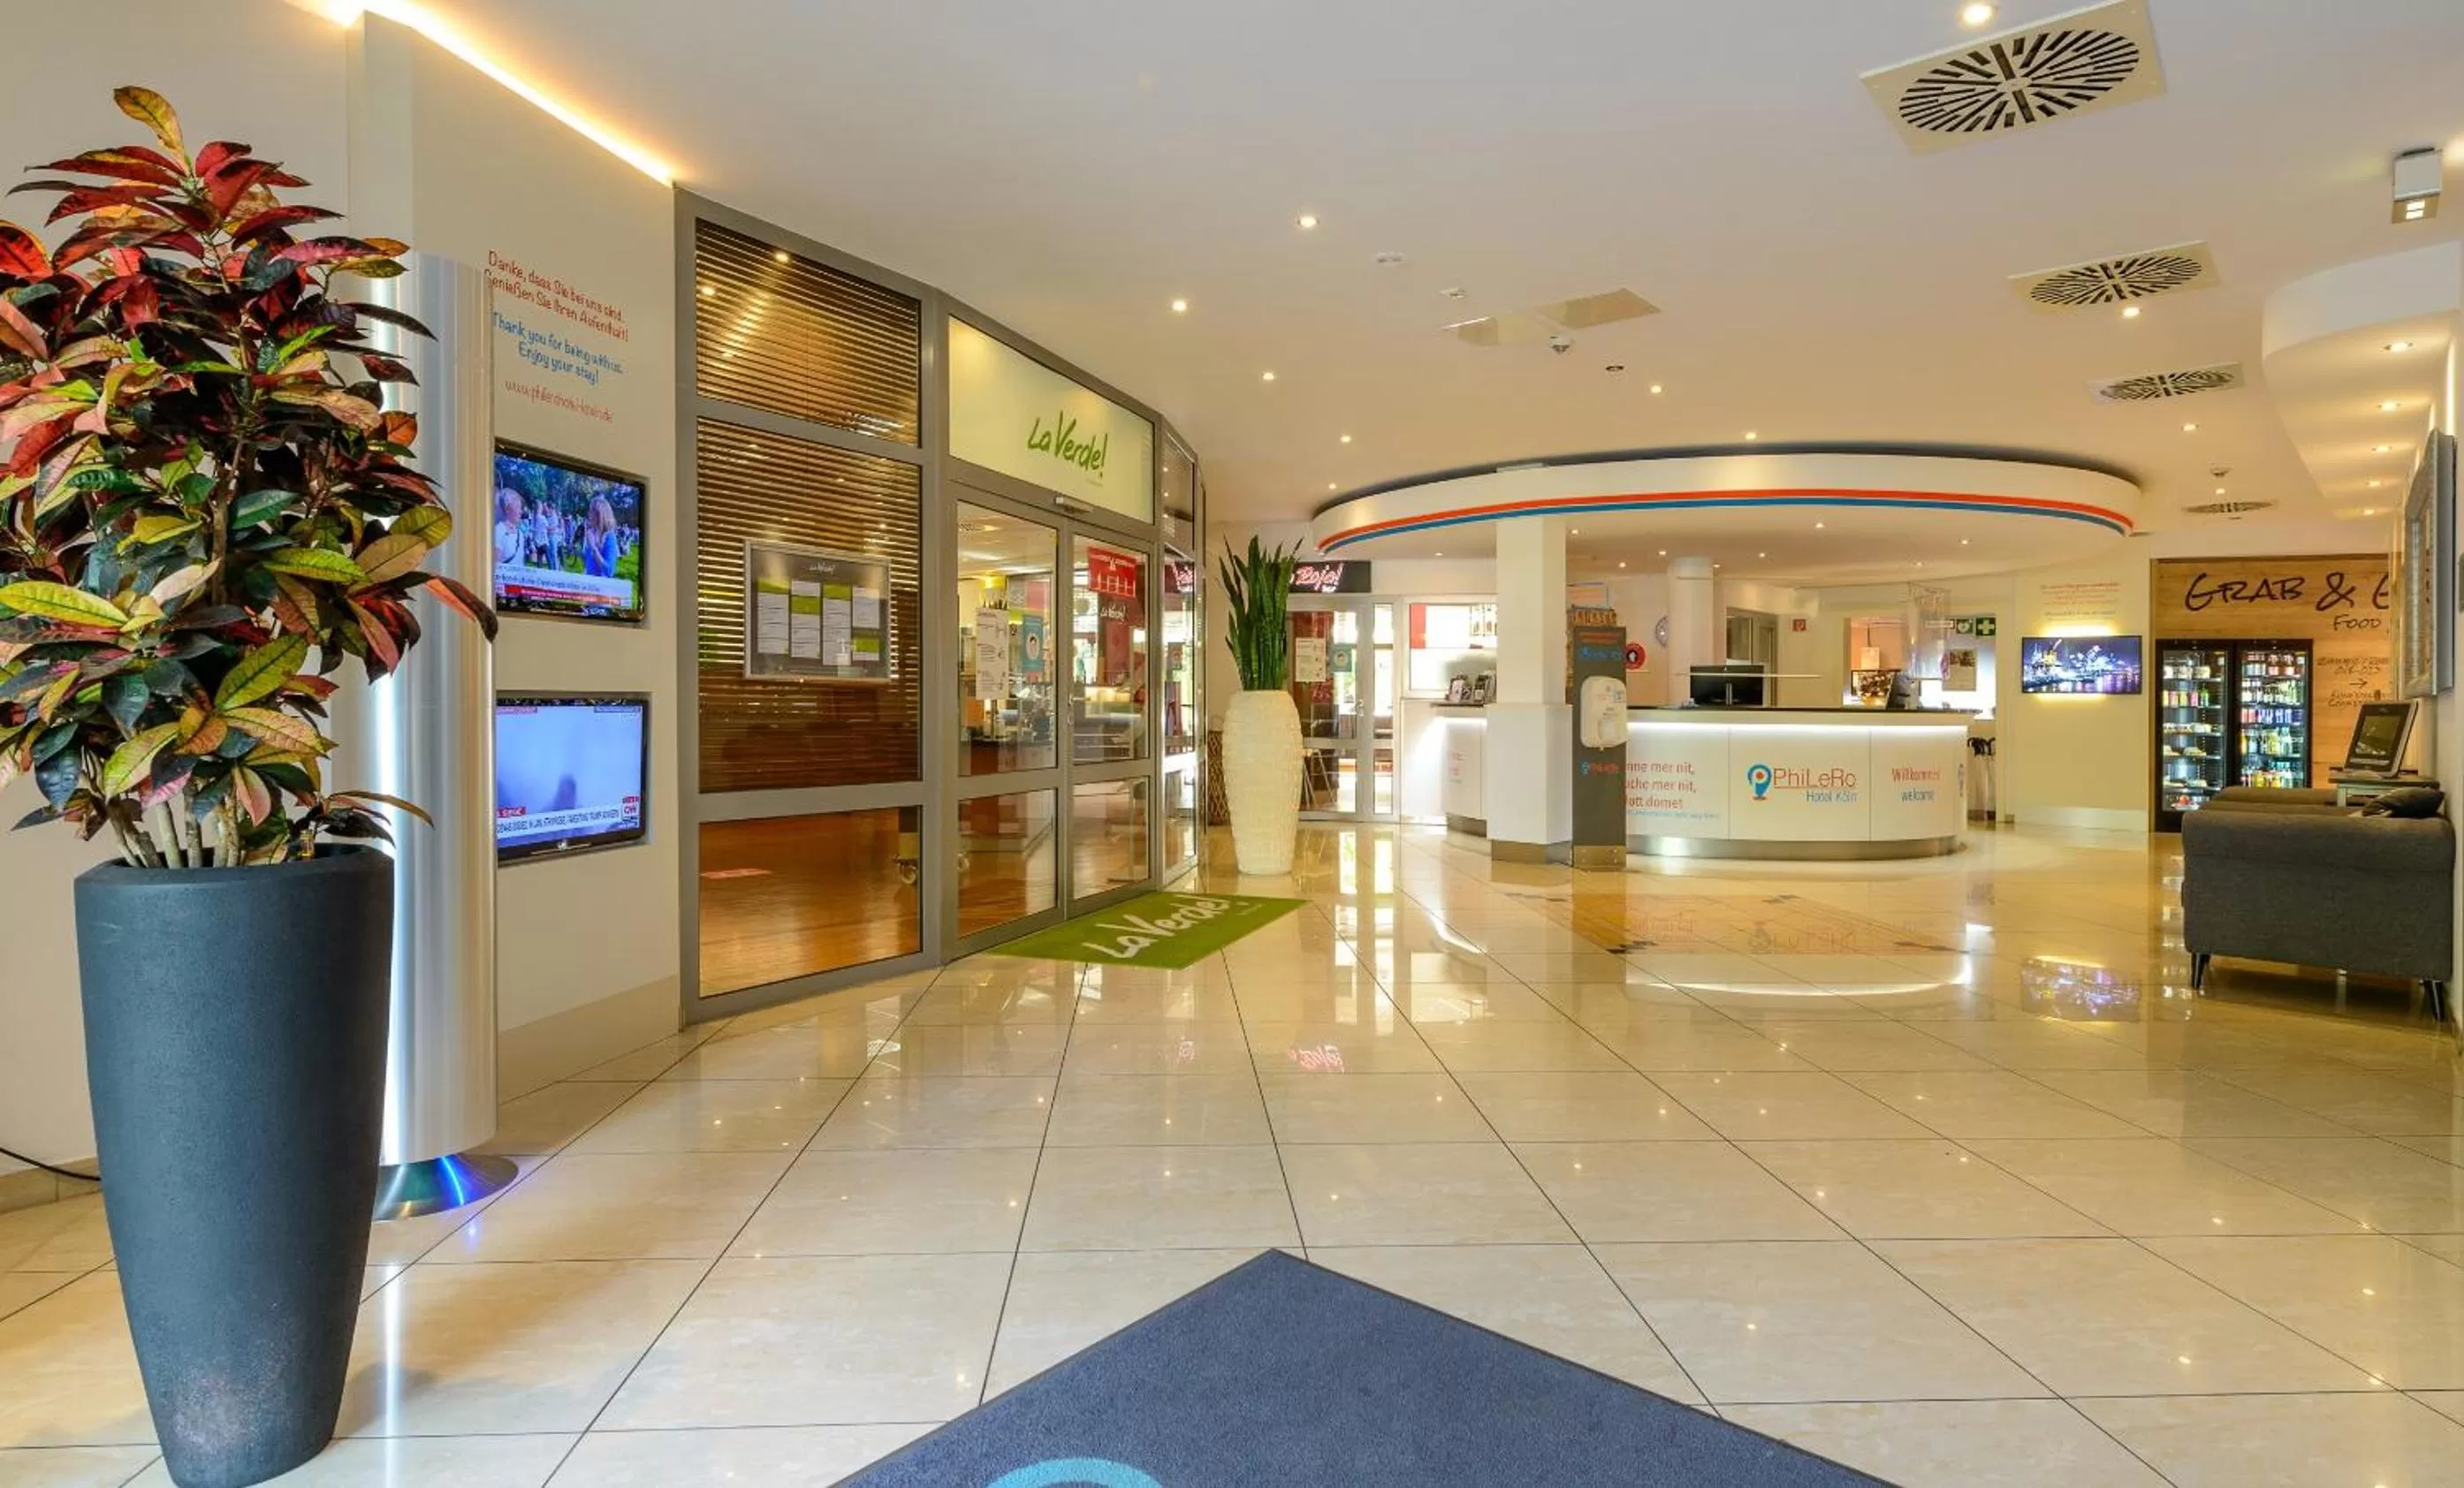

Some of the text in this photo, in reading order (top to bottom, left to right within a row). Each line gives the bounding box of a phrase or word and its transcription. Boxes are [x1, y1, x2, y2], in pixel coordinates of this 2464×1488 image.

[492, 310, 526, 339] Thank
[529, 329, 546, 345] you
[518, 339, 550, 369] Enjoy
[551, 357, 574, 373] your
[1027, 410, 1109, 479] La Verde!
[2185, 573, 2306, 611] GRAB
[2316, 572, 2357, 611] &
[1773, 767, 1857, 788] PhiLeRo
[1081, 893, 1250, 959] La Verde!
